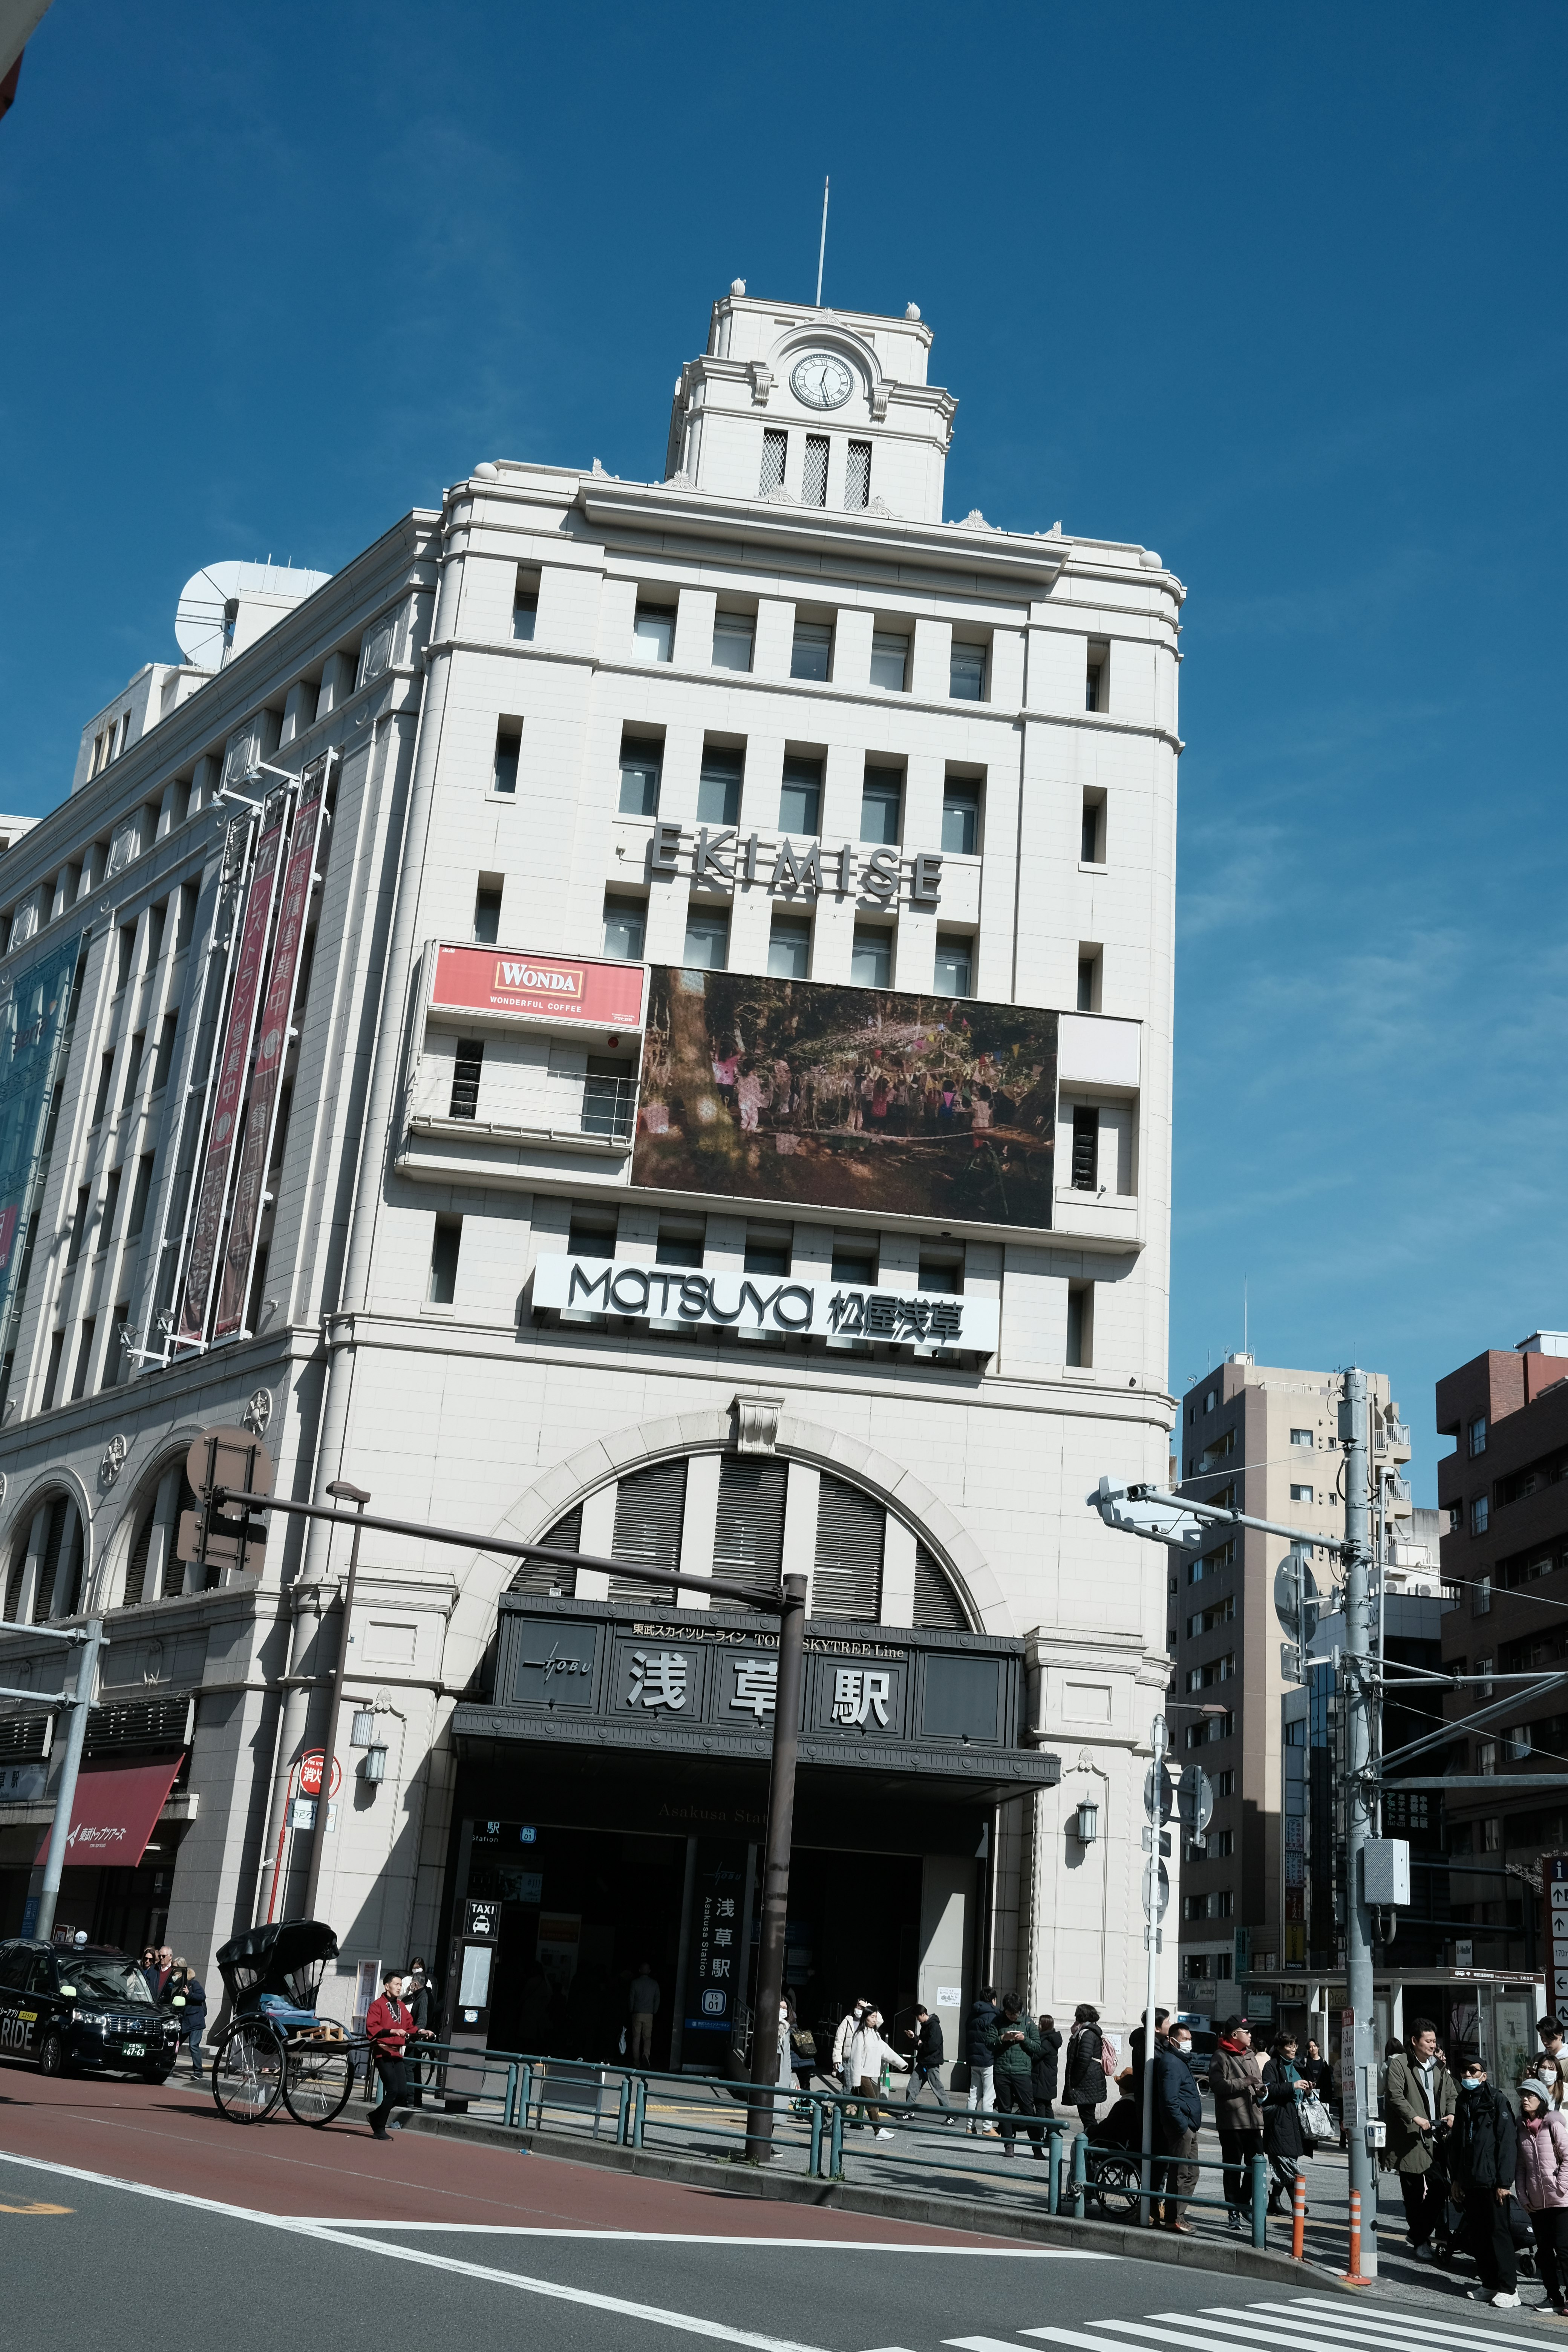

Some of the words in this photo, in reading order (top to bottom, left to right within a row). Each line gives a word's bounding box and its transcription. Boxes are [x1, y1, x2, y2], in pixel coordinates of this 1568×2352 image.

[297, 821, 313, 847] 7F
[259, 845, 274, 874] 7F
[652, 822, 943, 903] EKIMISE
[501, 962, 576, 992] WONDA
[222, 887, 266, 1104] レストラン営業中
[490, 996, 544, 1009] WONDERFUL
[548, 1003, 582, 1013] COFFEE
[197, 1170, 214, 1237] FLOOR
[188, 1248, 201, 1305] OPEN
[828, 1289, 965, 1340] 松屋浅草
[632, 1623, 746, 1643] 東武スカイツリーライン
[755, 1634, 780, 1647] TO
[802, 1638, 871, 1655] SKYTREE
[874, 1644, 904, 1658] Line
[545, 1660, 592, 1673] TOBU
[626, 1650, 890, 1727] 浅草駅
[303, 1766, 324, 1784] 消火
[487, 1822, 500, 1834] 駅
[658, 1803, 727, 1821] Asakusa
[735, 1810, 768, 1824] Stat
[78, 1827, 127, 1841] 東武トップツアーズ
[472, 1904, 495, 1914] TAXI
[702, 1897, 712, 1938] Asakusa
[711, 1898, 734, 1978] 浅草駅
[700, 1941, 709, 1977] Station
[708, 2001, 718, 2010] 01
[1, 2018, 35, 2051] RIDE
